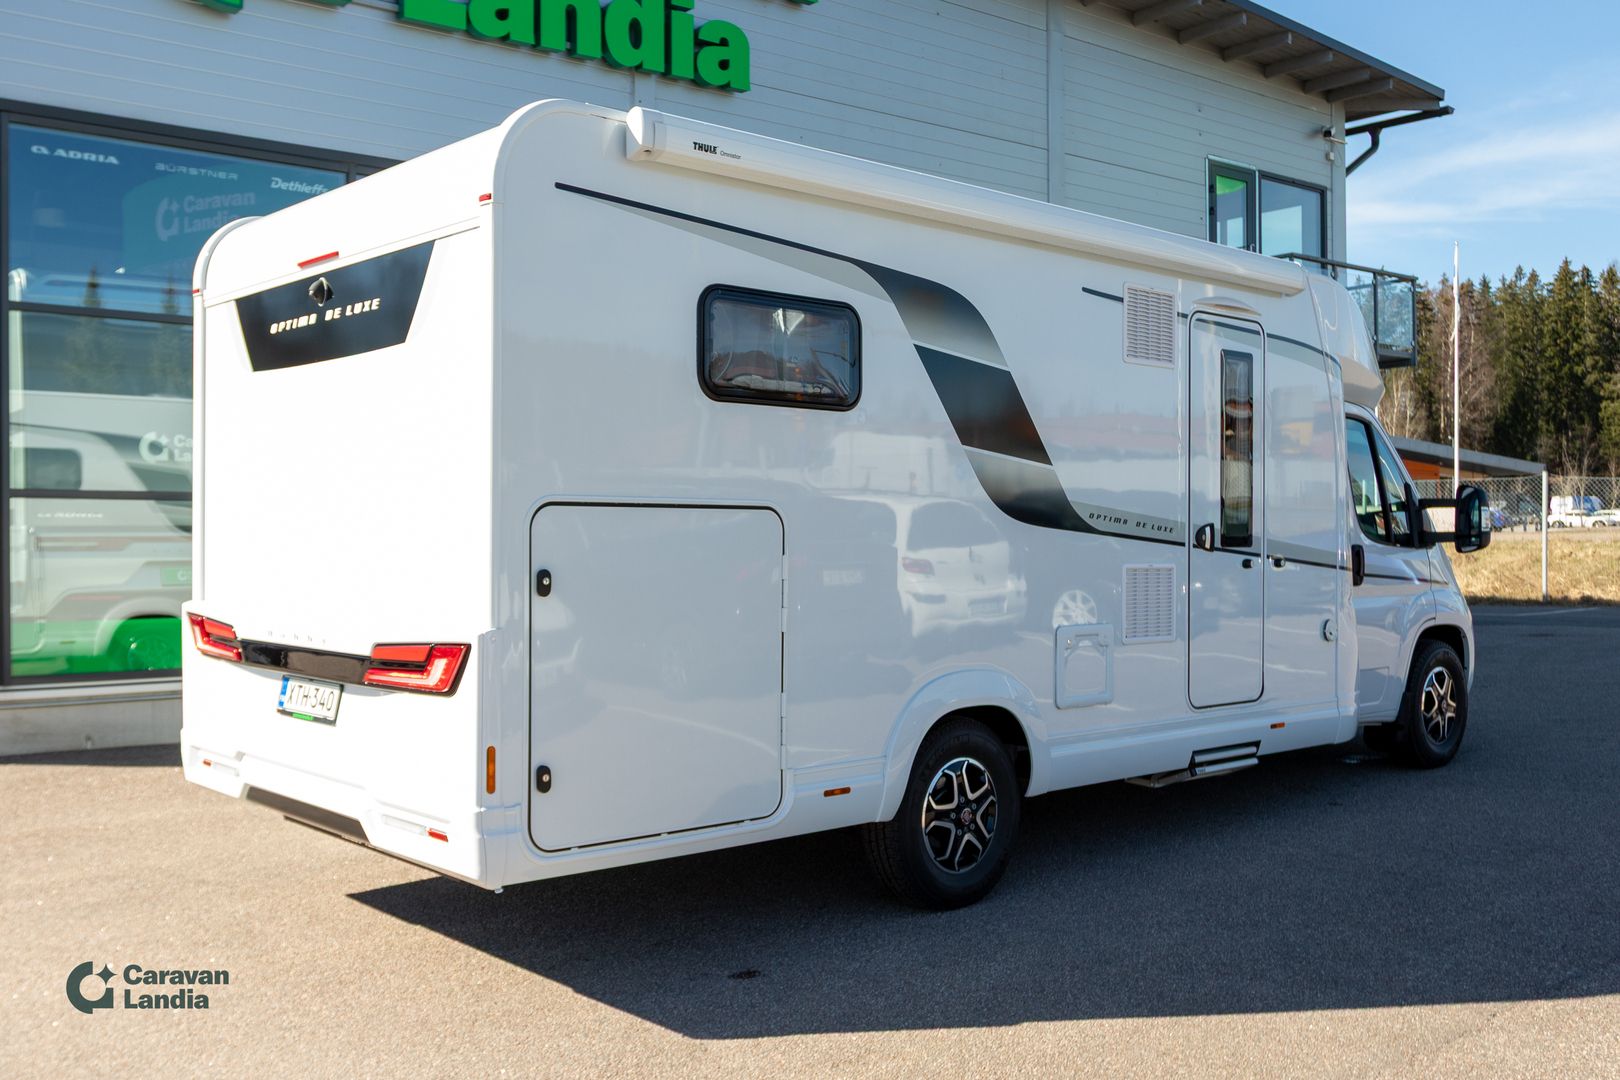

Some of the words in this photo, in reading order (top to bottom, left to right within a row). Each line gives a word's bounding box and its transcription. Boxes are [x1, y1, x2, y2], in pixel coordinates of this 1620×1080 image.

[53, 148, 119, 165] ADRIA
[692, 141, 718, 155] THULE
[183, 192, 256, 213] Caravan
[184, 210, 240, 233] Landi
[269, 313, 318, 335] OPTIMA
[324, 307, 342, 321] DE
[345, 298, 381, 316] LUXE
[1089, 512, 1128, 526] OPTIMA
[1135, 521, 1148, 529] DE
[1151, 523, 1175, 534] LUXE
[287, 683, 335, 712] XTH-340
